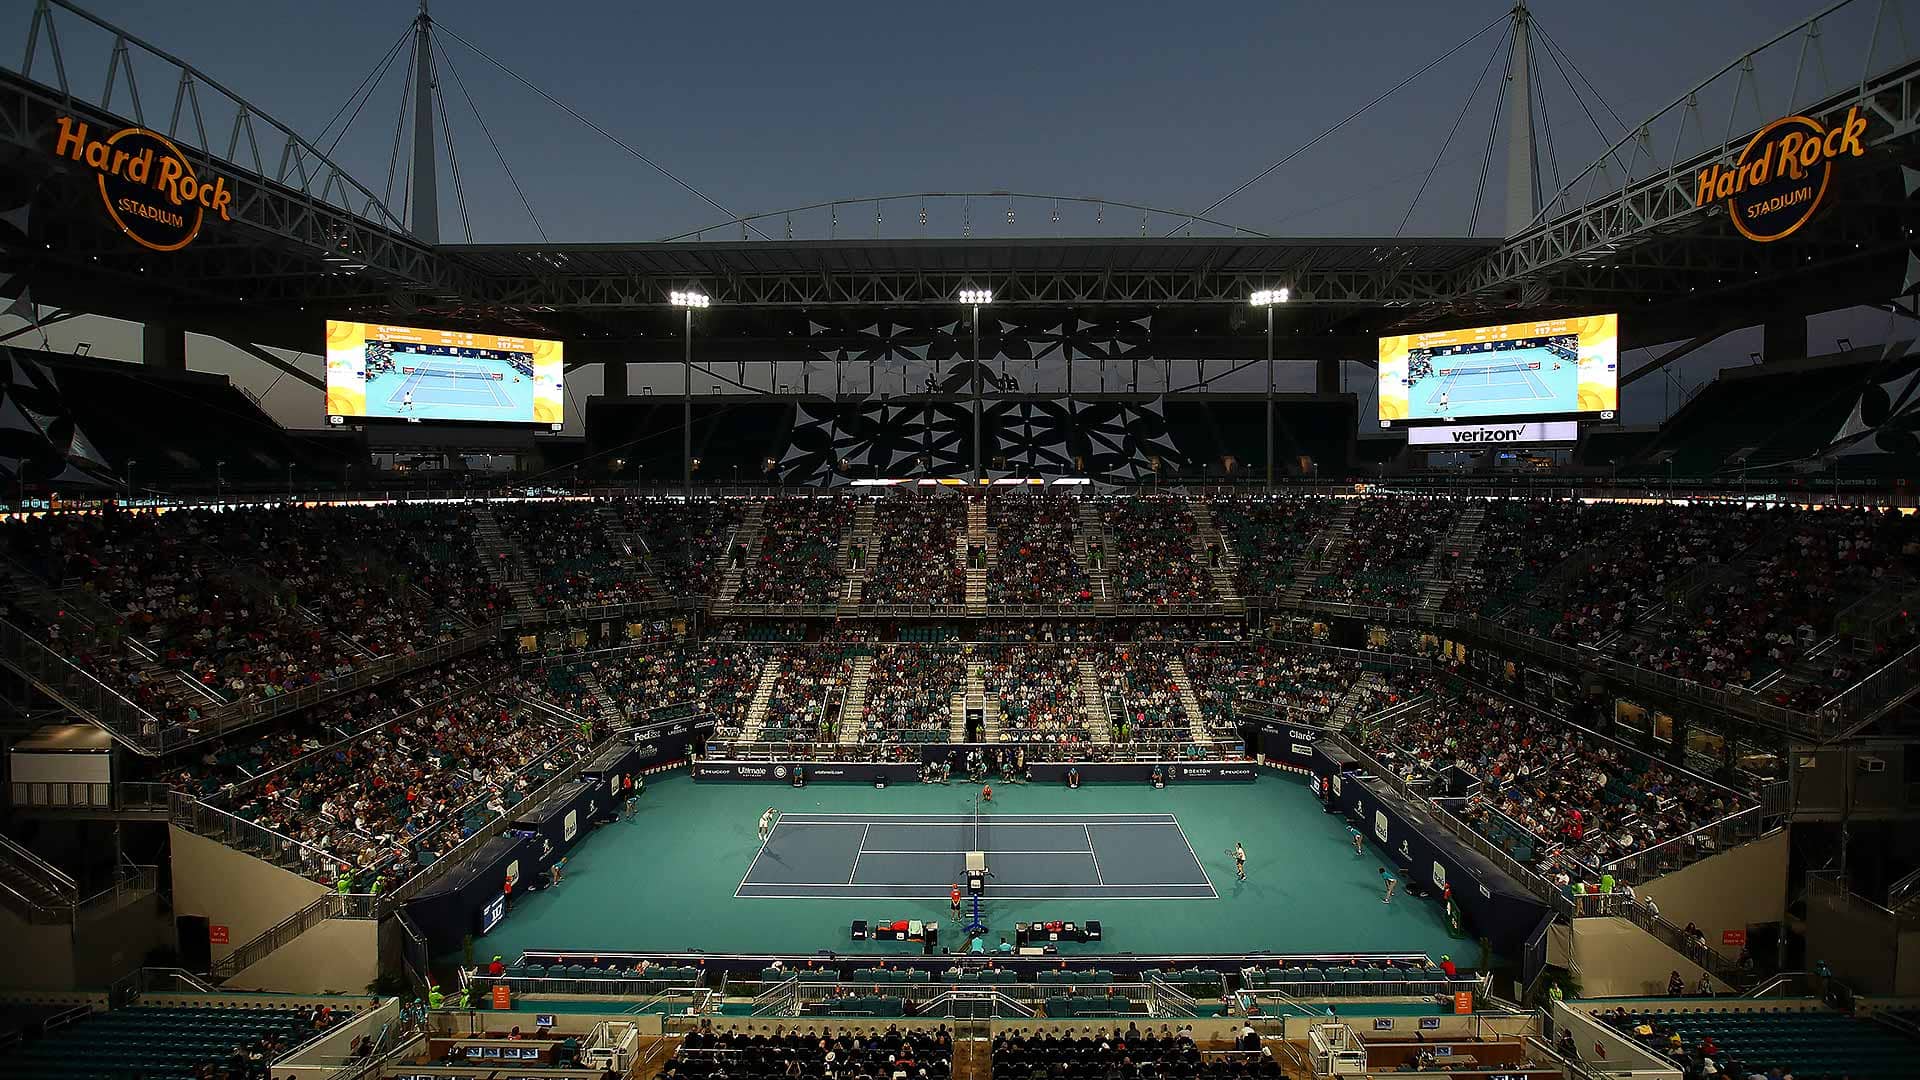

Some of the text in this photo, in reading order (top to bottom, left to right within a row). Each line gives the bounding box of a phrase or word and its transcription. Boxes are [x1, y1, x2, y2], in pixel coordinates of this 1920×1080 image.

[1696, 106, 1867, 207] Hard Rock
[56, 116, 232, 221] Hard Rock
[1747, 187, 1811, 218] STADIUM
[118, 198, 183, 228] STADIUM
[332, 416, 342, 424] CC
[1602, 411, 1613, 419] CC
[1452, 427, 1517, 443] verizon
[1289, 729, 1312, 741] Claro
[738, 766, 767, 775] Ultimate
